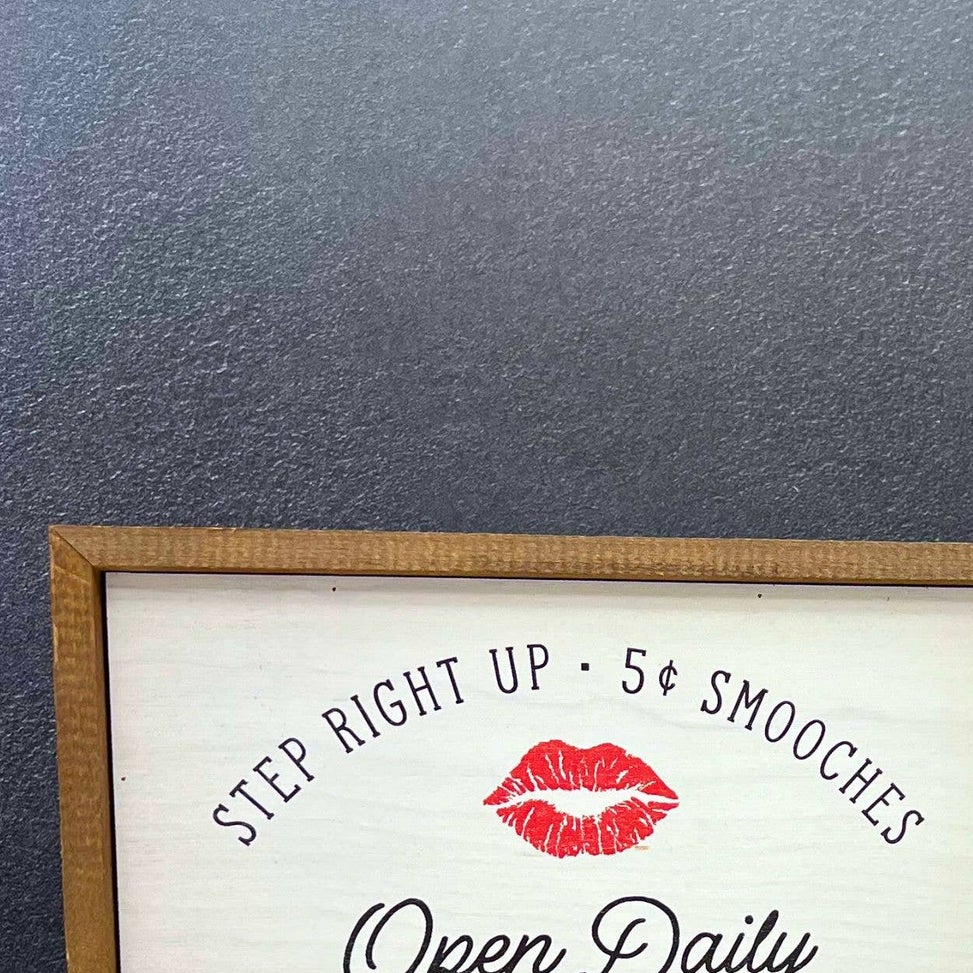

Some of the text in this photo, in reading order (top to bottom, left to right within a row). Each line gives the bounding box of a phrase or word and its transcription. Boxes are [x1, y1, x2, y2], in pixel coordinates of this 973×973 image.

[212, 643, 925, 847] STEP RIGHT UP 5¢ SMOOCHES
